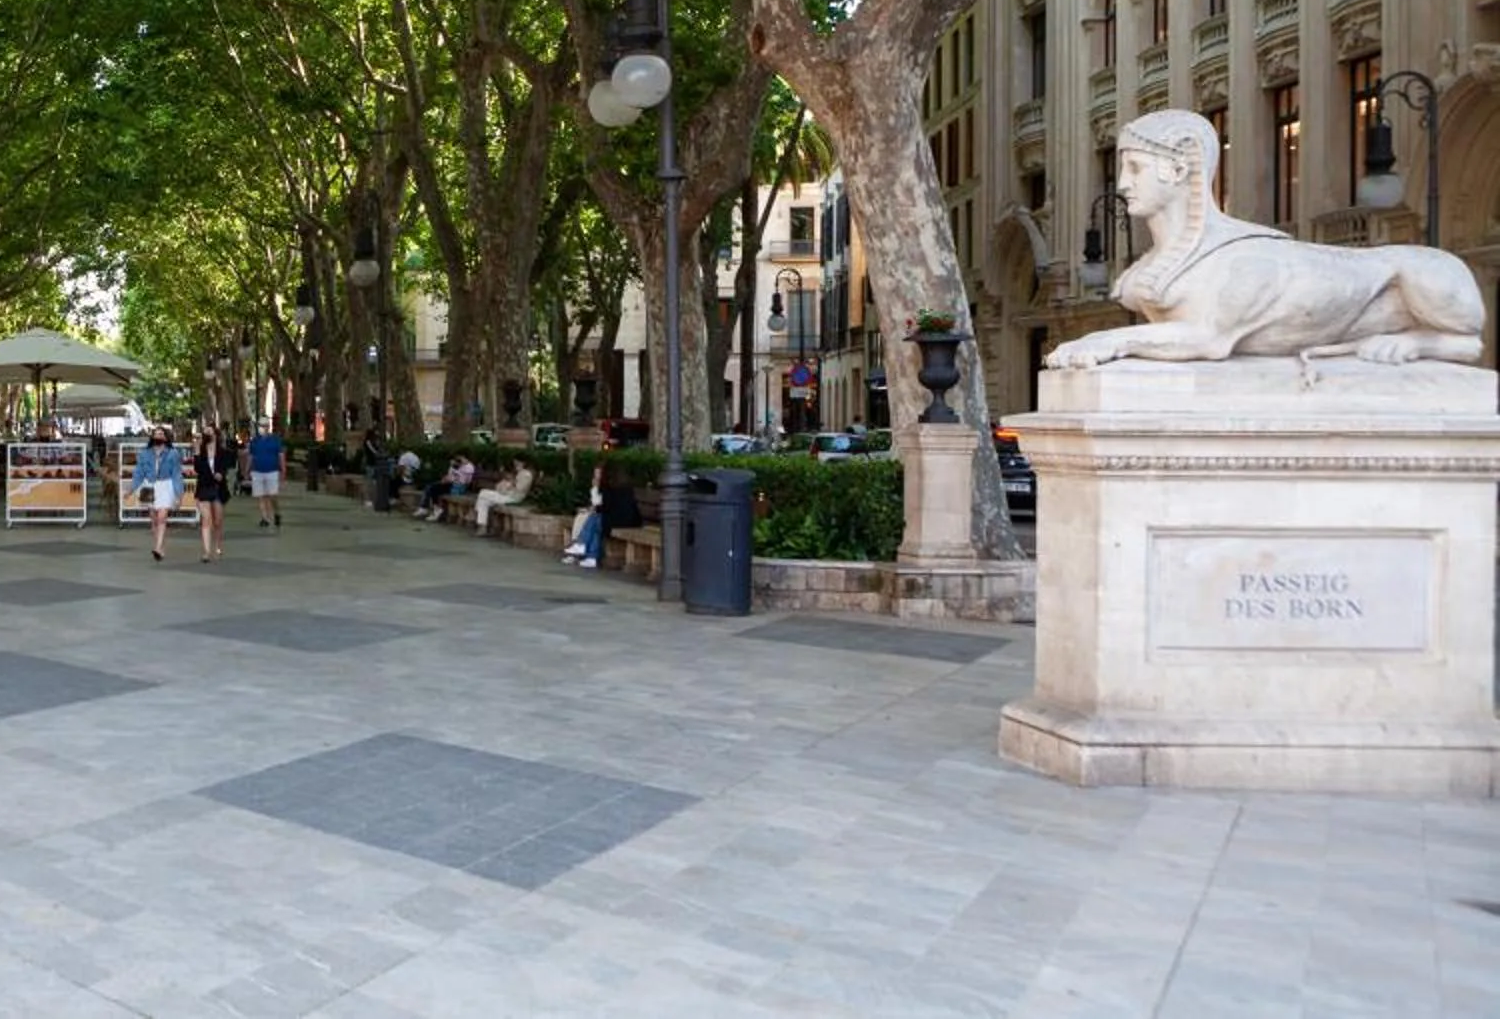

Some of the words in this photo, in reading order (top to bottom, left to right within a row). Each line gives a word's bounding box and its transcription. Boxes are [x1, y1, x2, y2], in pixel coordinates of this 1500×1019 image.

[1238, 573, 1350, 594] PASSEIG
[1225, 598, 1276, 619] DES
[1289, 598, 1364, 620] BORN
